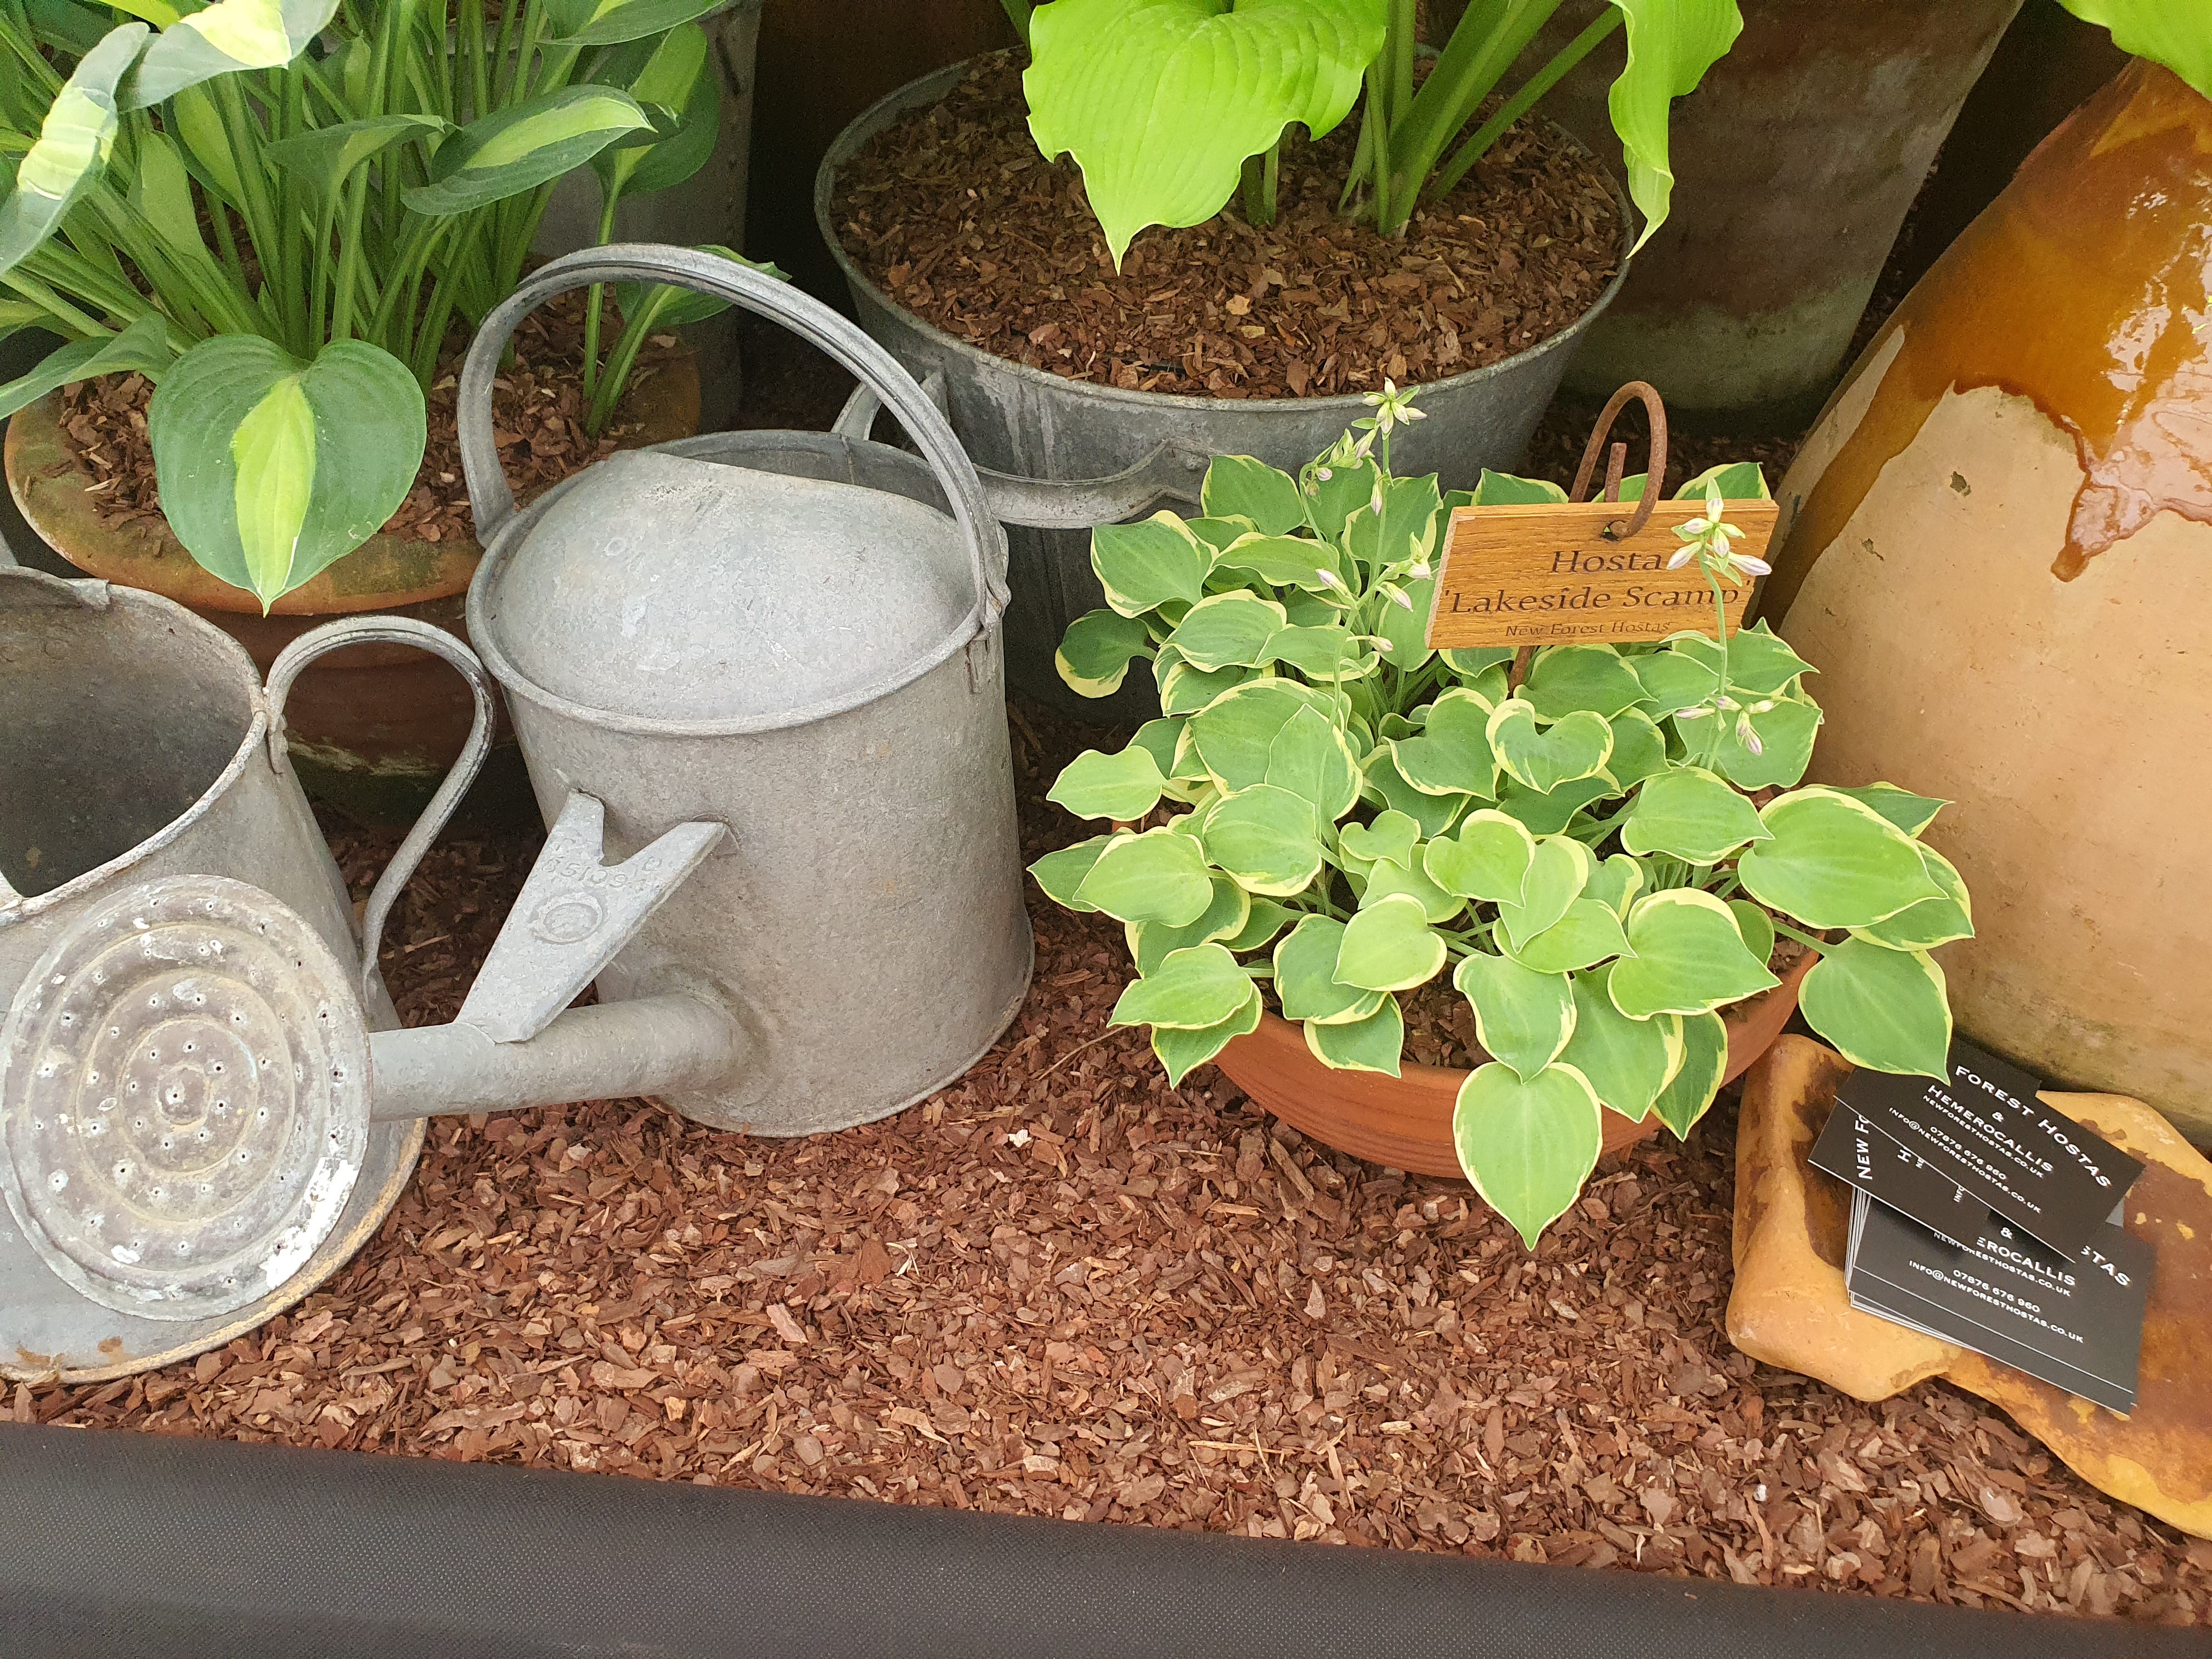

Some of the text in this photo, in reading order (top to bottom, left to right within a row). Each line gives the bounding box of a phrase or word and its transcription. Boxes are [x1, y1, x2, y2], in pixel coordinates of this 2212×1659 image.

[1551, 550, 1663, 574] Hosta
[1505, 620, 1672, 637] New Forest Hostas
[1923, 1095, 2044, 1179] NEWFORESTHOSTAS.CO.UK
[1927, 1084, 2054, 1172] HEMEROCALLIS
[1955, 1065, 2112, 1187] FOREST HOSTAS
[1991, 1111, 2005, 1123] &
[1856, 1138, 1873, 1180] NEW
[1888, 1107, 2042, 1214] INFO@NEWFORESTHOSTAS.CO.UK
[1929, 1126, 2007, 1181] 07876 676 960
[2000, 1227, 2013, 1240] &
[1909, 1260, 2084, 1344] INFO@NEWFORESTHOSTAS.CO.UK
[1953, 1269, 2041, 1313] 07876 676 960
